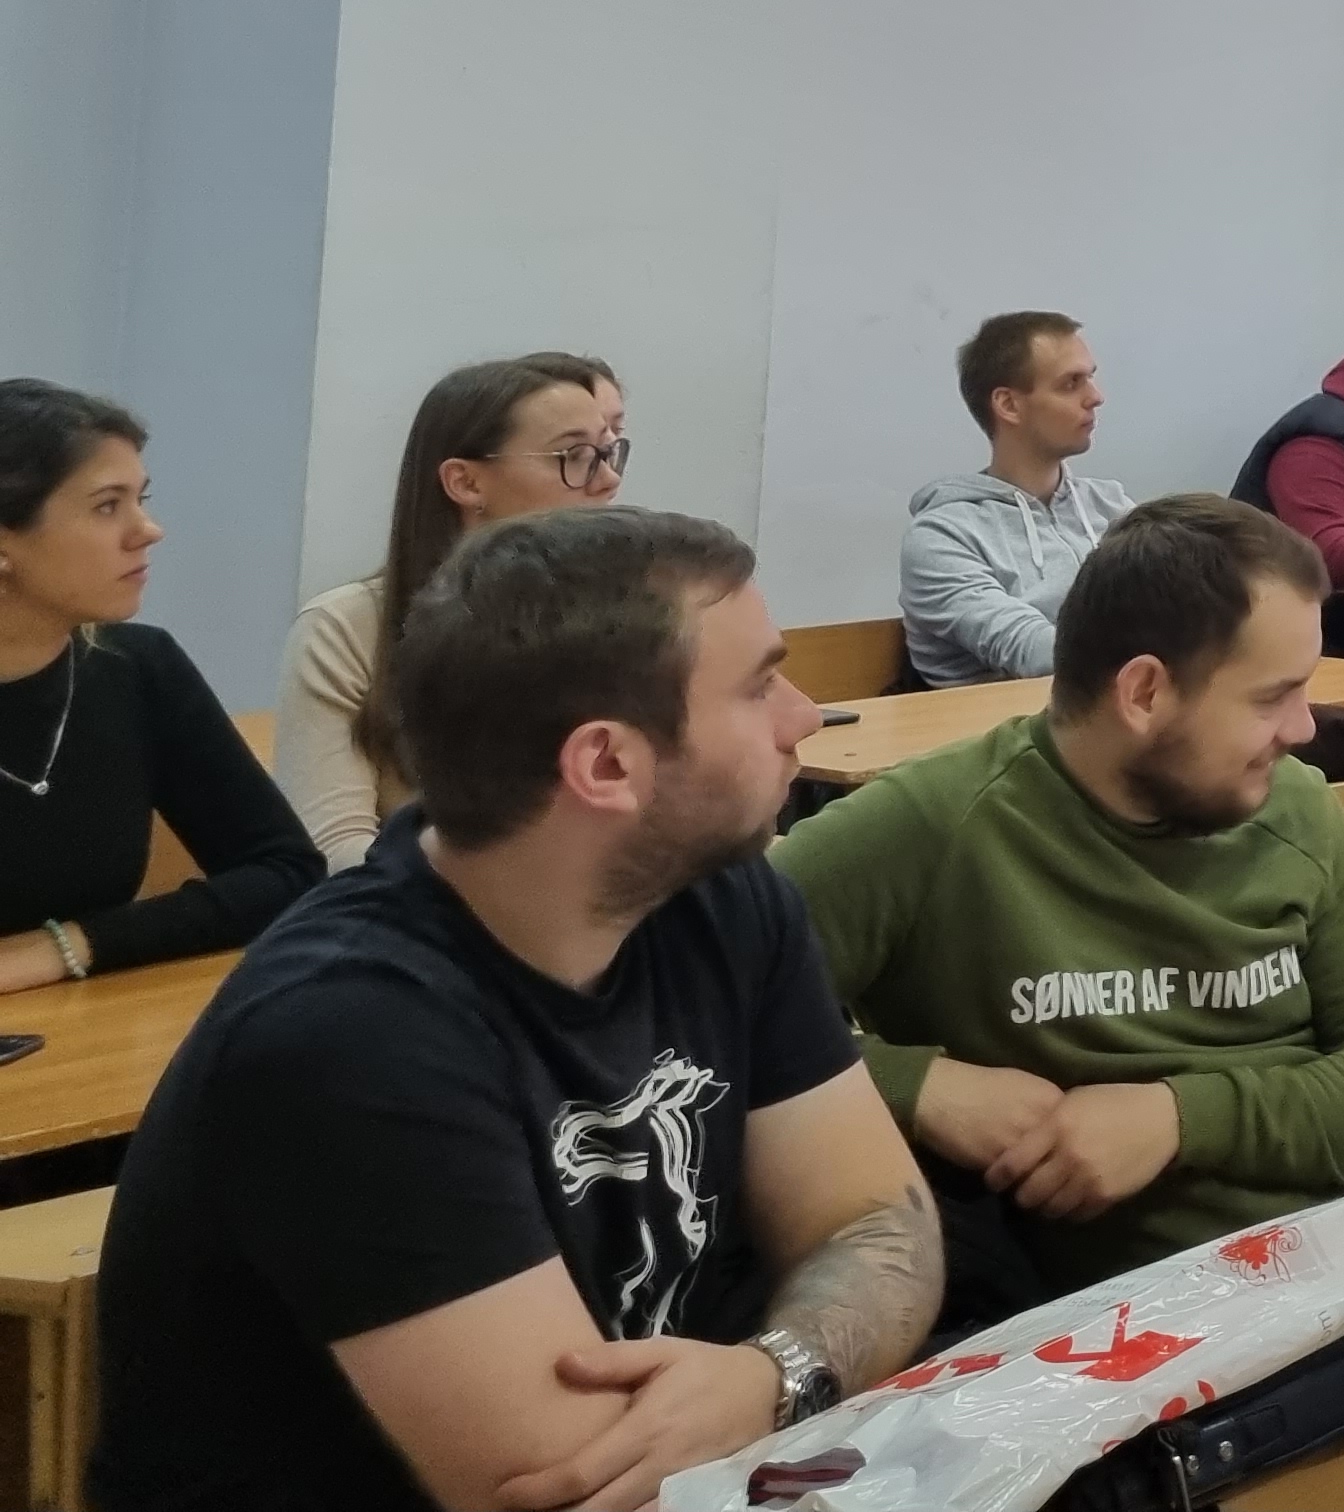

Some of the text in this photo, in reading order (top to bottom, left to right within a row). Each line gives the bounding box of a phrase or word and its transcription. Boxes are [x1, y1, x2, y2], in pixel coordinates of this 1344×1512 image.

[1011, 943, 1301, 1024] SØNNER AF VINDEN
